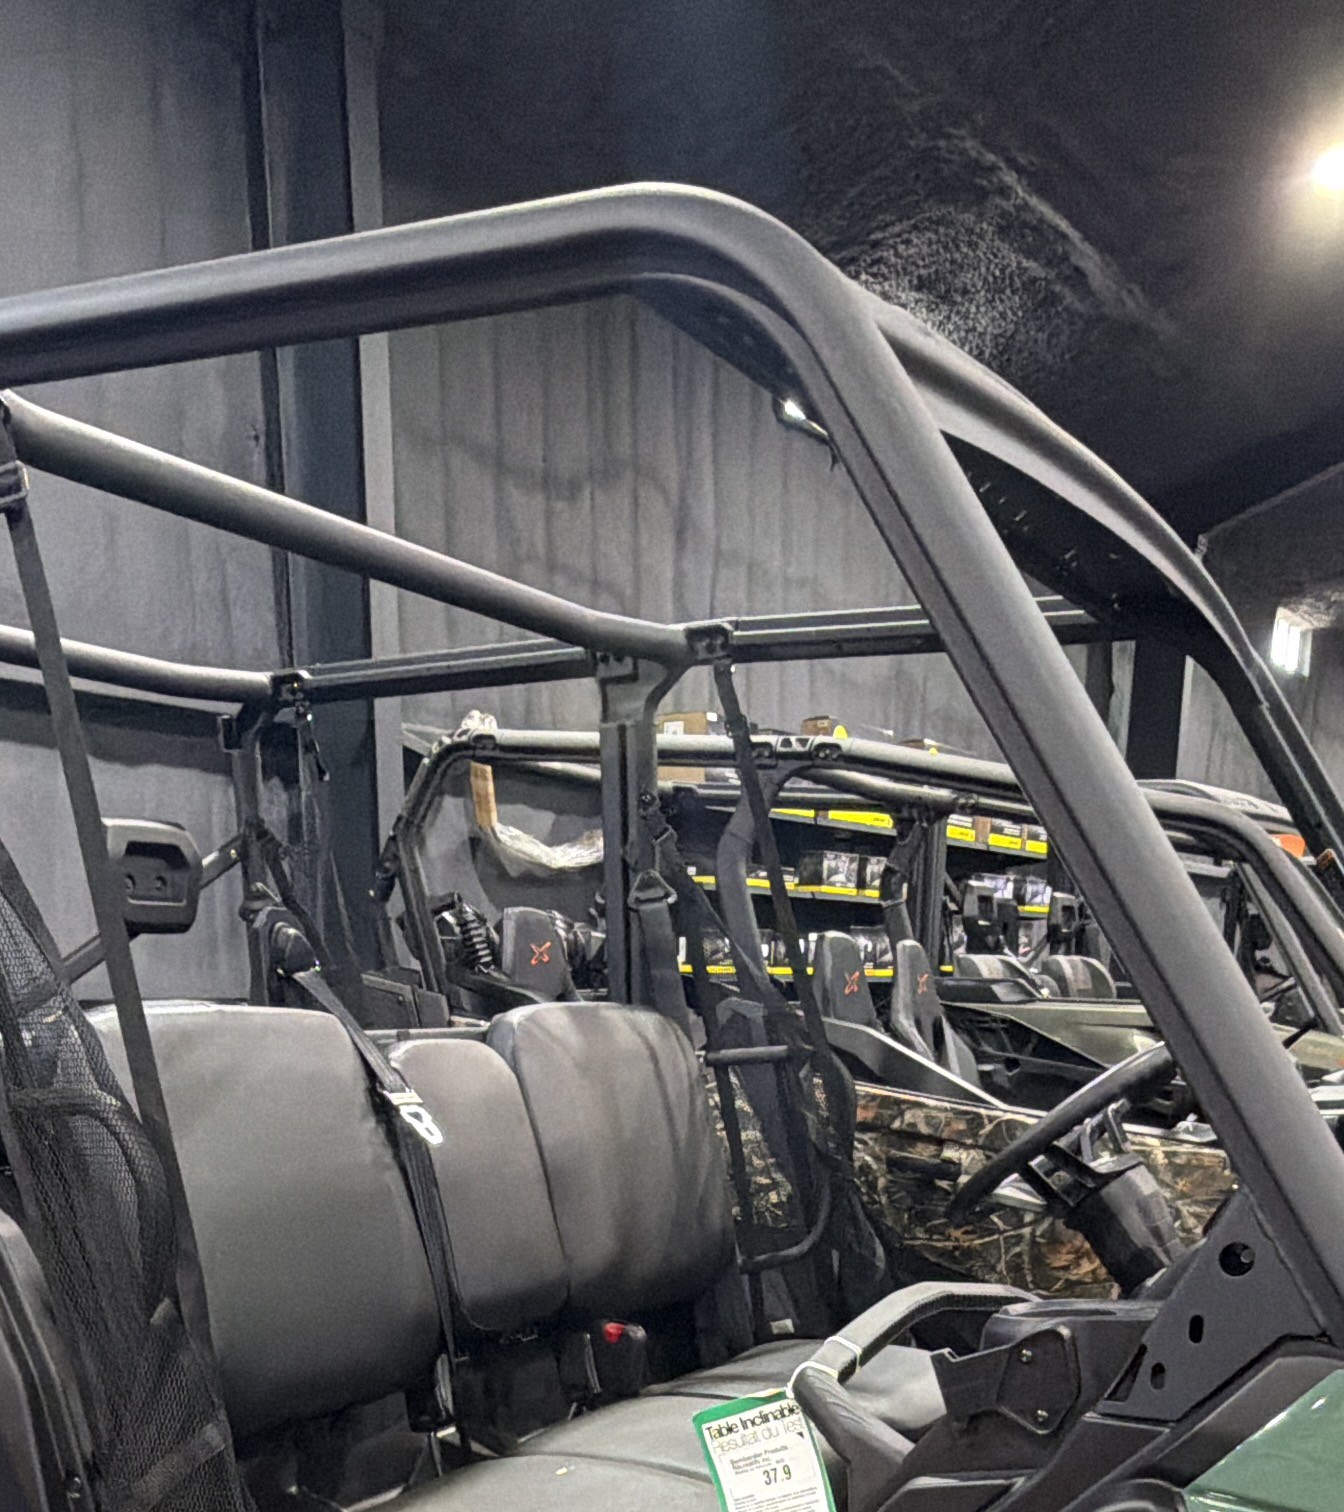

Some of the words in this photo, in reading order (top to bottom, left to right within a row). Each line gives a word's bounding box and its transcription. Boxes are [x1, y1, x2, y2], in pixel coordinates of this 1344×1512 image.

[705, 1421, 740, 1441] Table
[739, 1402, 800, 1431] Inclinable
[762, 1463, 793, 1486] 37.9
